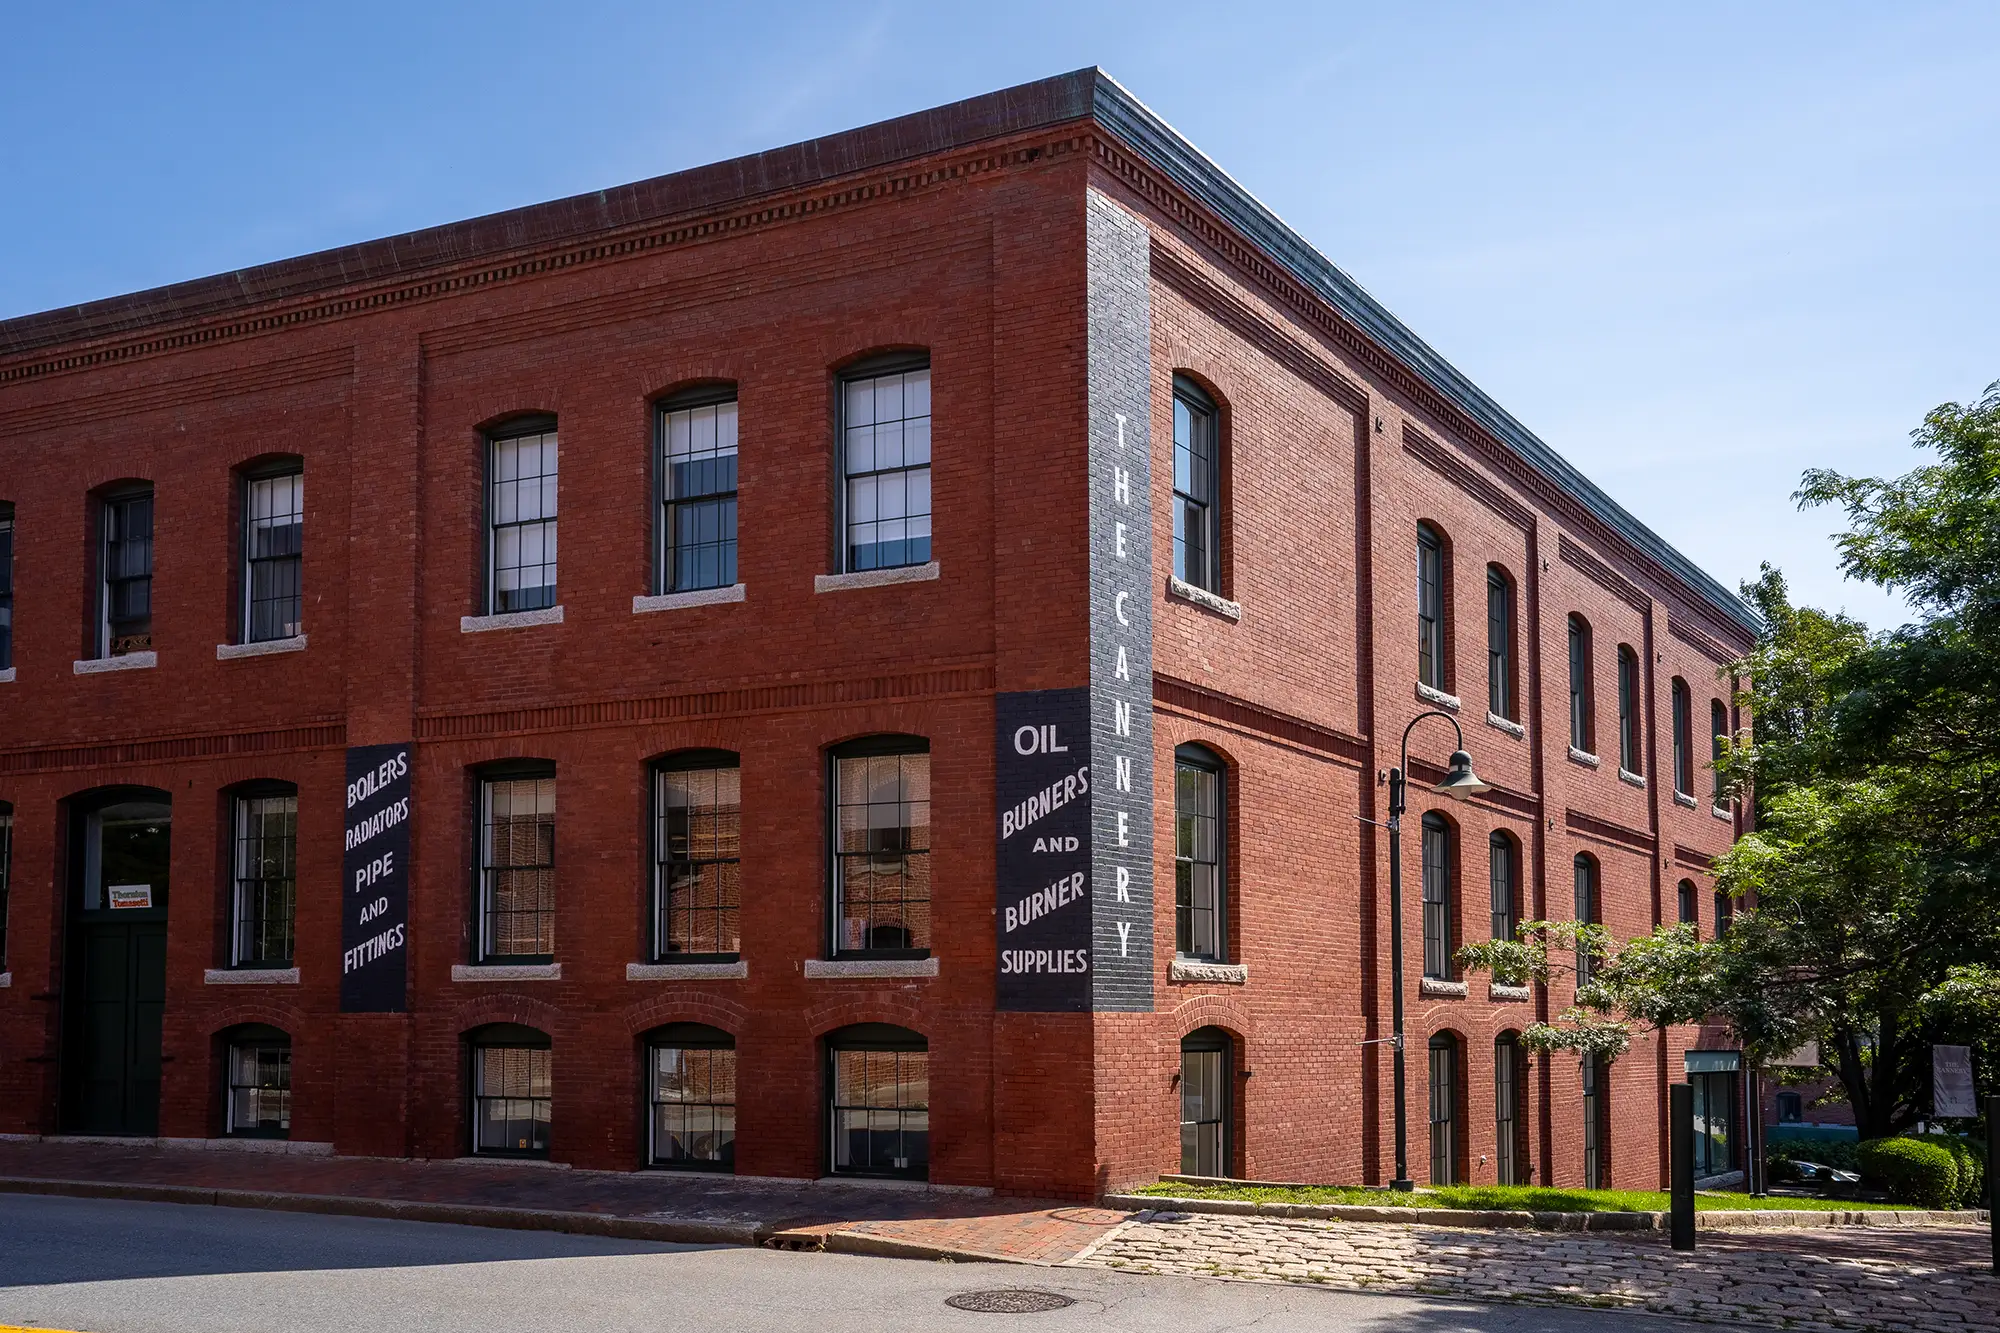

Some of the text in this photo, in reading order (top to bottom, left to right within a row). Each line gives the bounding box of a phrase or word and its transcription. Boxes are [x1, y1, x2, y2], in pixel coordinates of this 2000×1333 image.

[1115, 412, 1132, 958] THE CANNERY
[1014, 724, 1069, 756] OIL
[347, 751, 408, 809] BOILERS
[1002, 766, 1089, 840] BURNERS
[345, 796, 409, 852] RADIATORS
[1032, 836, 1080, 853] AND
[355, 851, 394, 893] PIPE
[359, 896, 388, 926] AND
[1005, 871, 1085, 933] BURNER
[344, 923, 405, 974] FITTINGS
[1001, 949, 1088, 974] SUPPLIES
